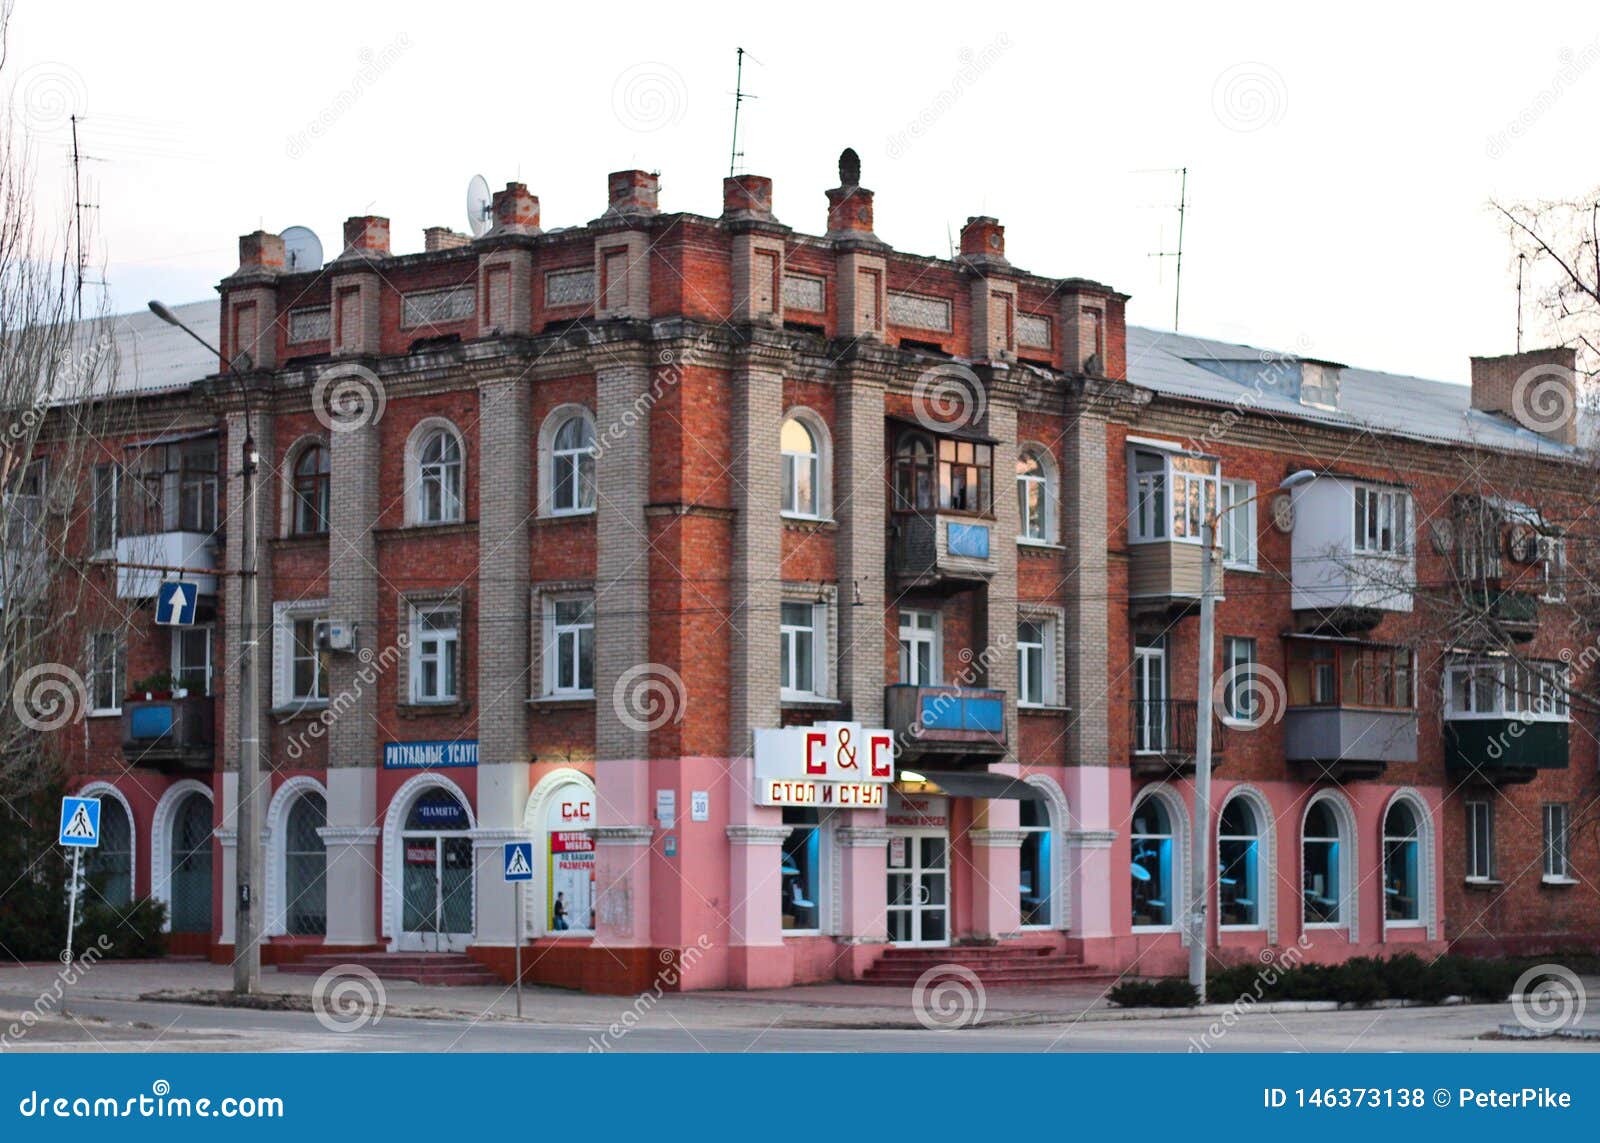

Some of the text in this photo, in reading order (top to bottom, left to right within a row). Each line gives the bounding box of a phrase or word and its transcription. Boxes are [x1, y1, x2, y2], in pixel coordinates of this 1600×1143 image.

[386, 745, 444, 765] РИТУАЛЬНЫЕ
[772, 783, 882, 803] СТОЛ И СТУЛ
[695, 802, 706, 813] 30
